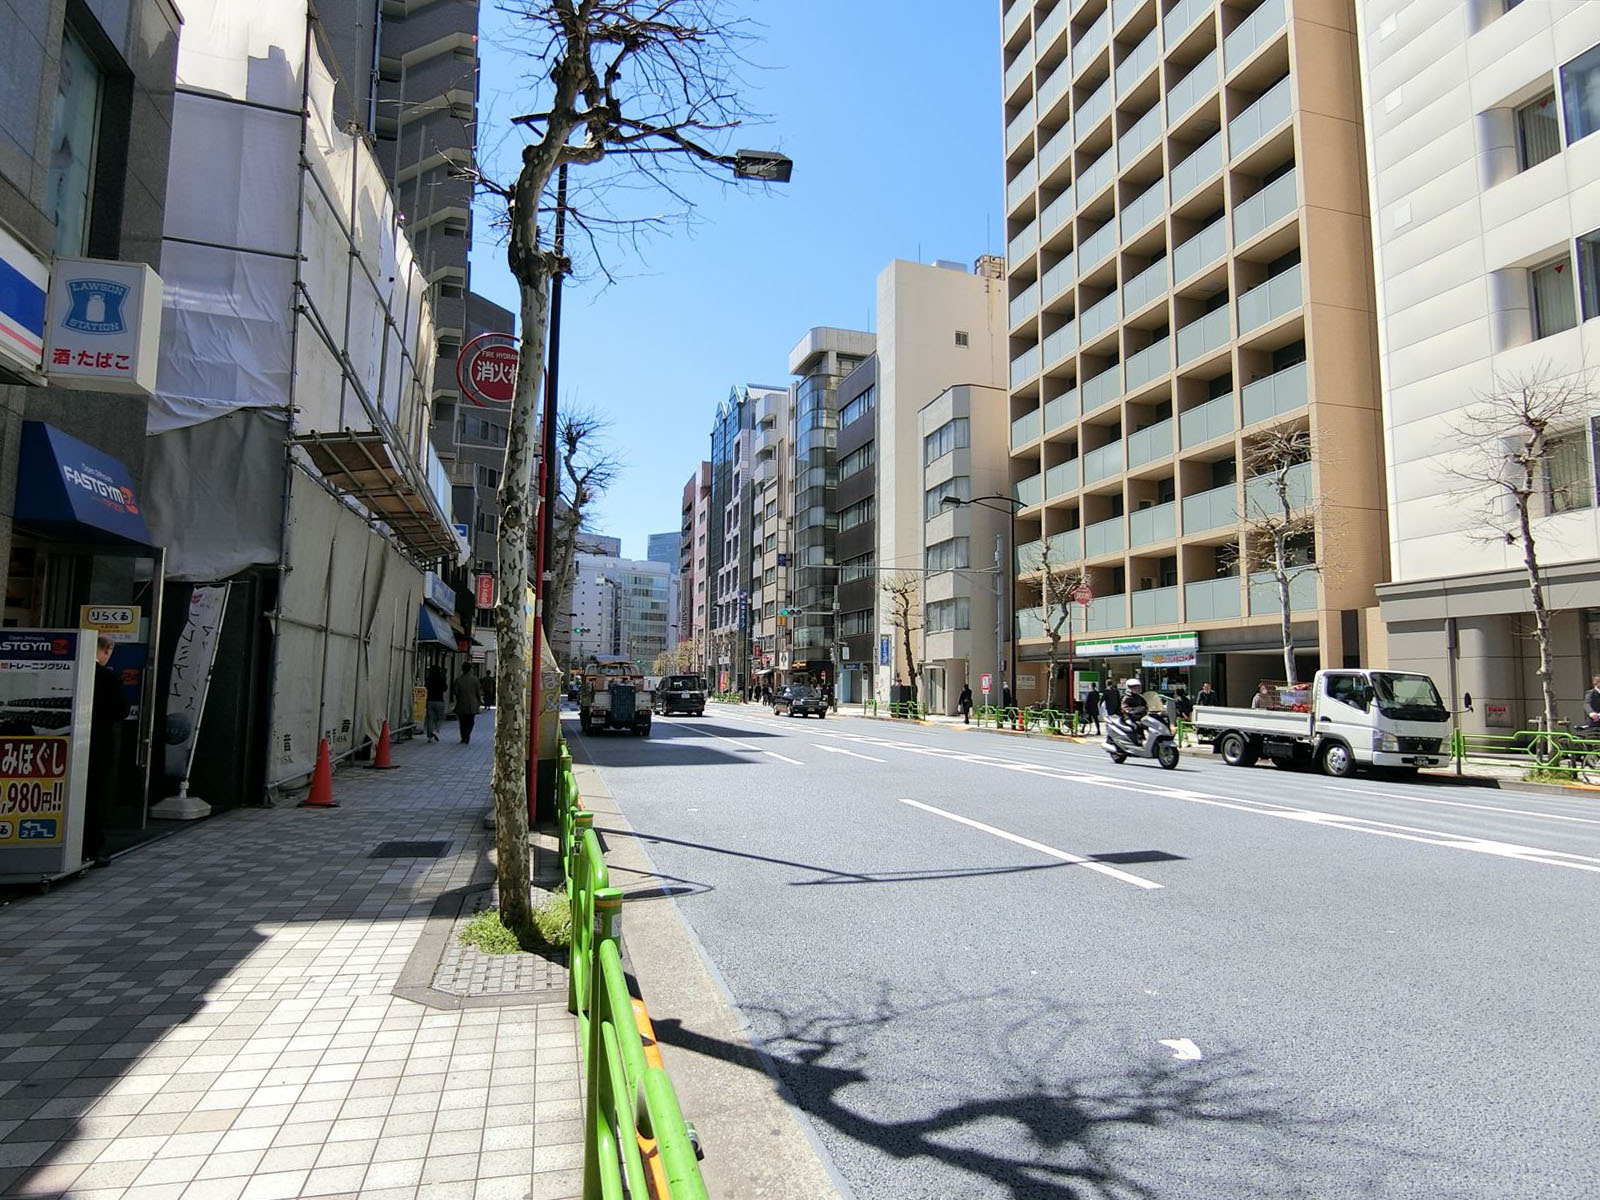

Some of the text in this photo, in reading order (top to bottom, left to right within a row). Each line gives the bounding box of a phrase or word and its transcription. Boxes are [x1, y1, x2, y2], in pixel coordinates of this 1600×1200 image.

[71, 282, 125, 296] LAWSON
[67, 318, 120, 332] STATION
[482, 350, 494, 358] FIRE
[91, 611, 129, 621] りらくる
[0, 641, 52, 652] STGYM
